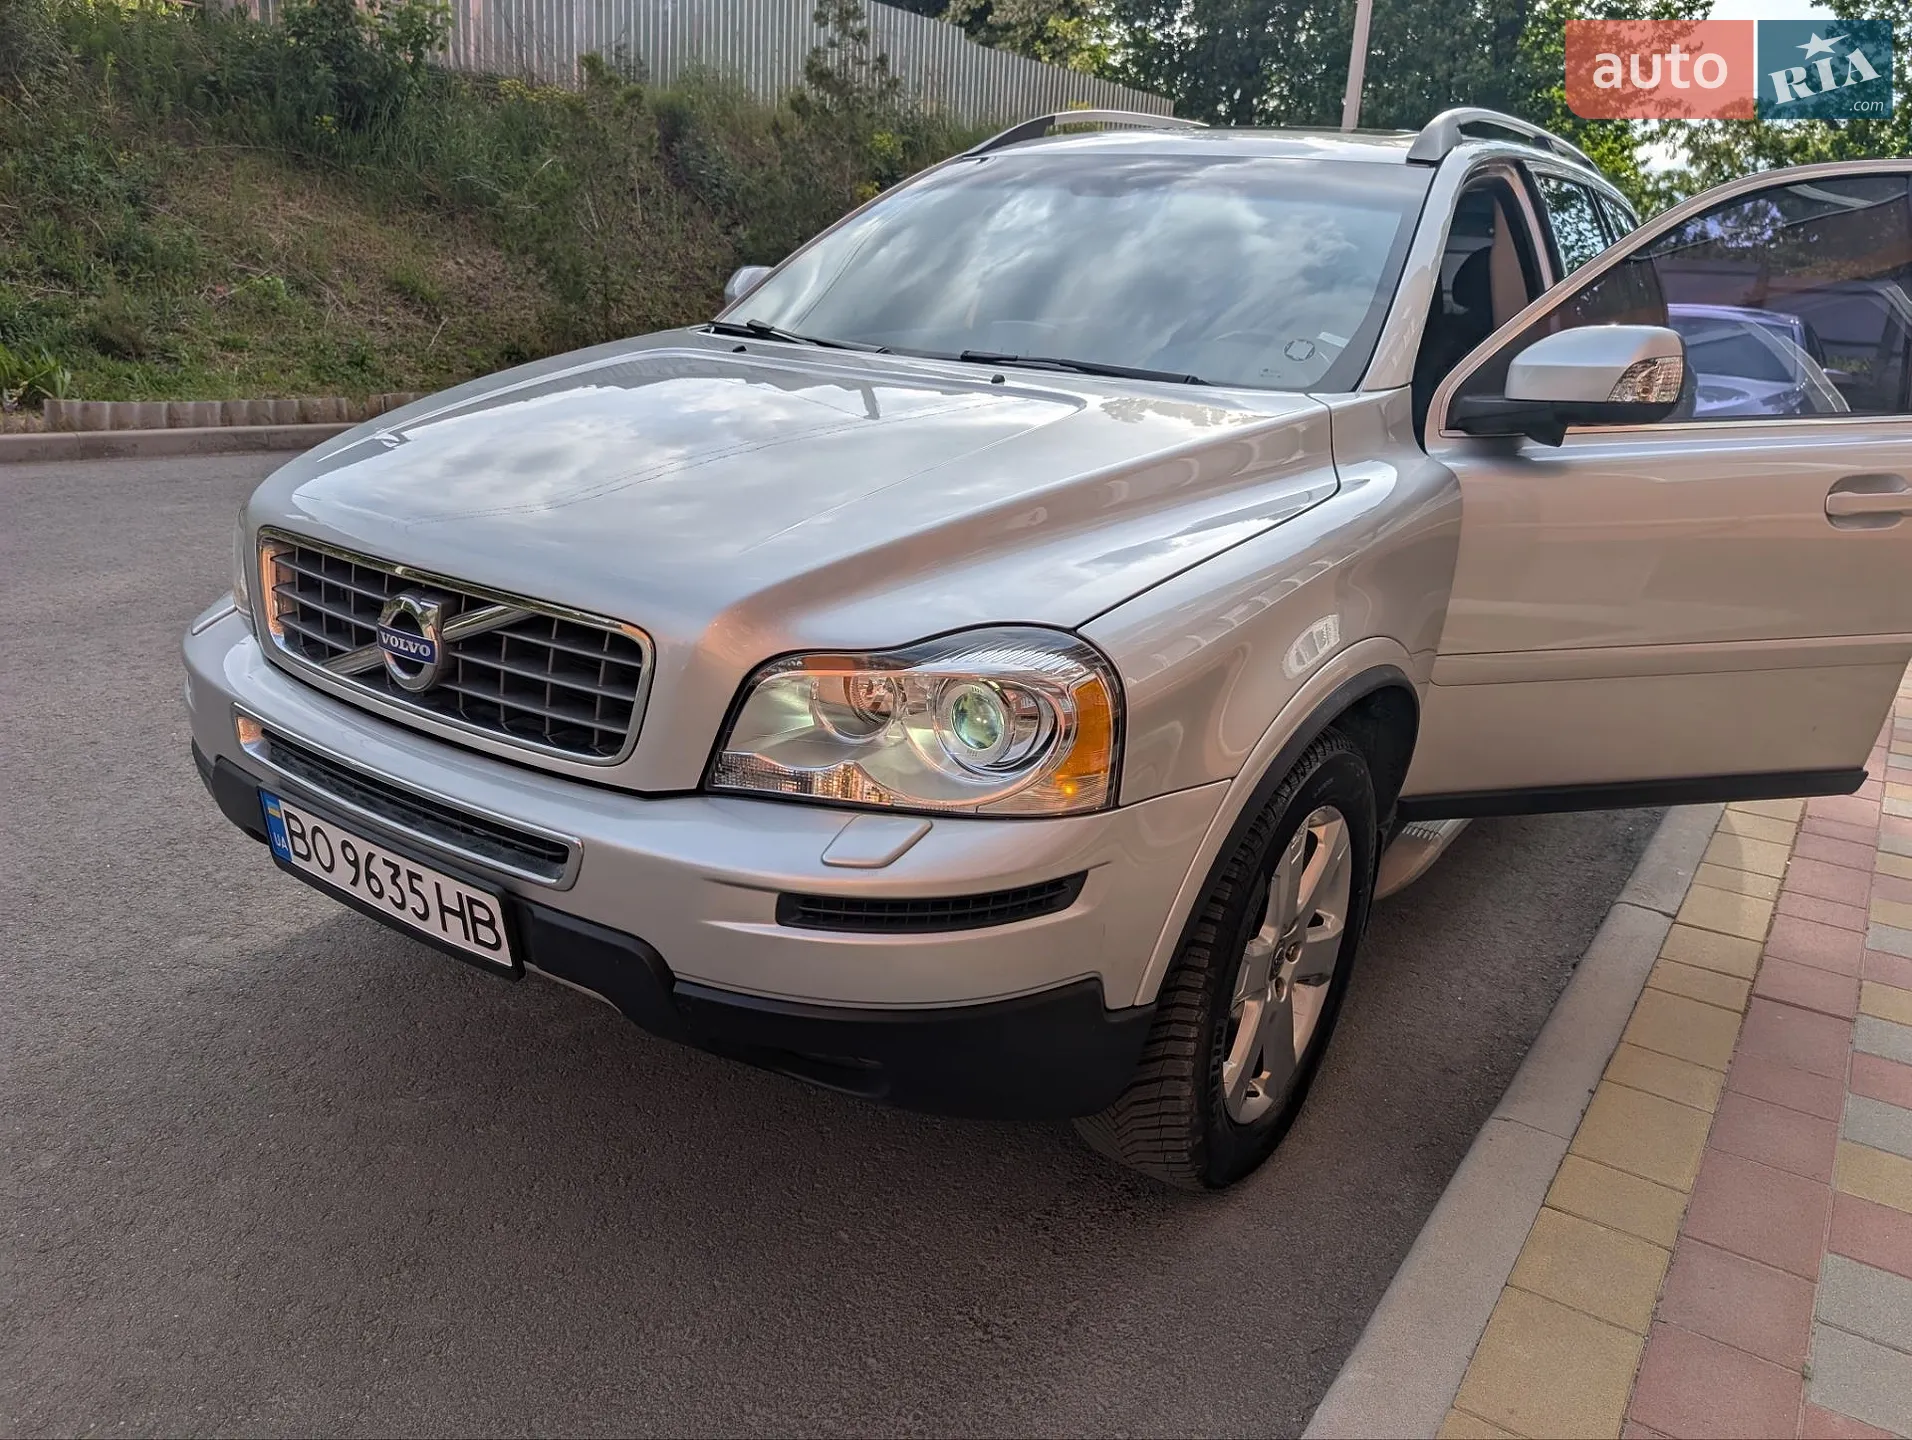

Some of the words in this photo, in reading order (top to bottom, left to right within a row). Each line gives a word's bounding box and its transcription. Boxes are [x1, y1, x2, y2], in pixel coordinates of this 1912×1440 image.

[380, 630, 431, 657] VOLVO
[274, 833, 289, 852] UA
[284, 809, 335, 874] BO
[340, 839, 430, 922] 9635
[434, 881, 502, 951] HB
